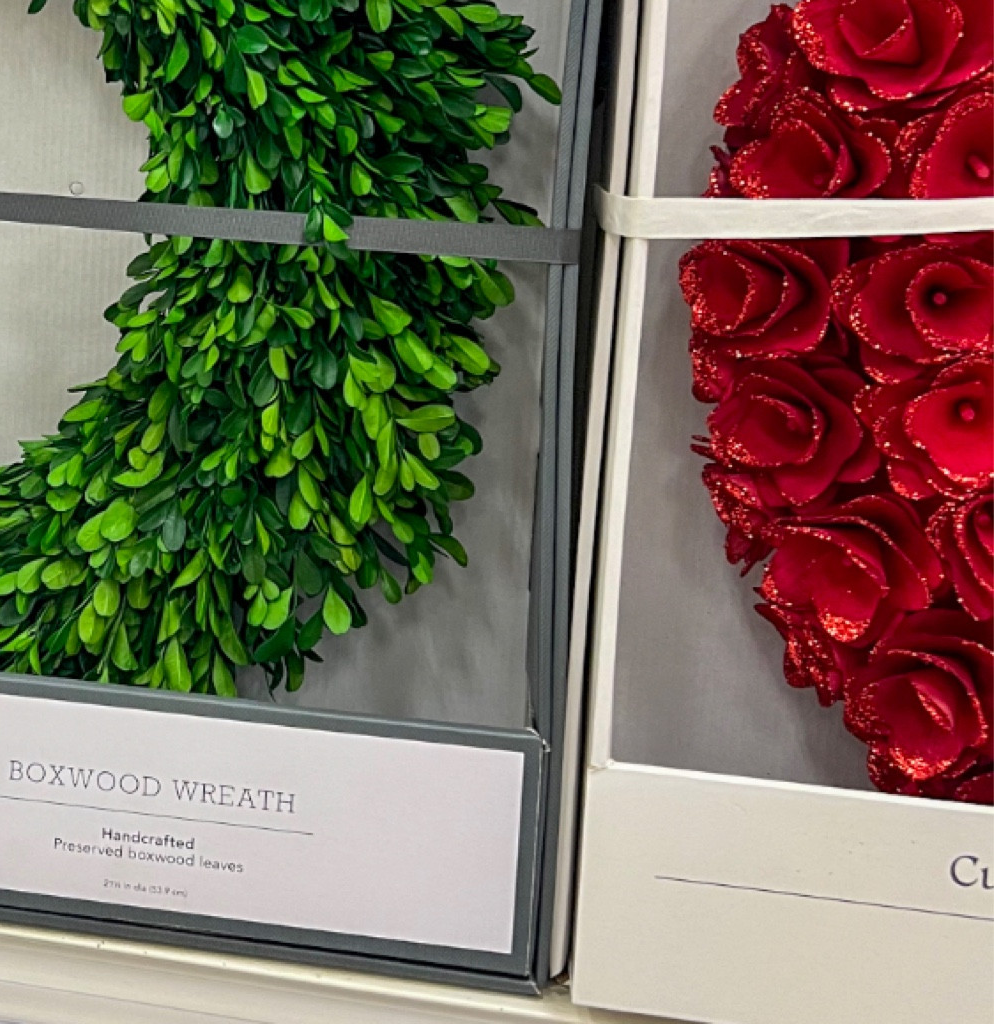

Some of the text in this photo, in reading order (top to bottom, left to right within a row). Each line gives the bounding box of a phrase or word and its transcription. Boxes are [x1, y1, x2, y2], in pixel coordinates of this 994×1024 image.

[9, 759, 296, 813] BOXWOOD WREATH
[54, 837, 244, 873] Preserved boxwood leaves
[101, 827, 196, 850] Handcrafted
